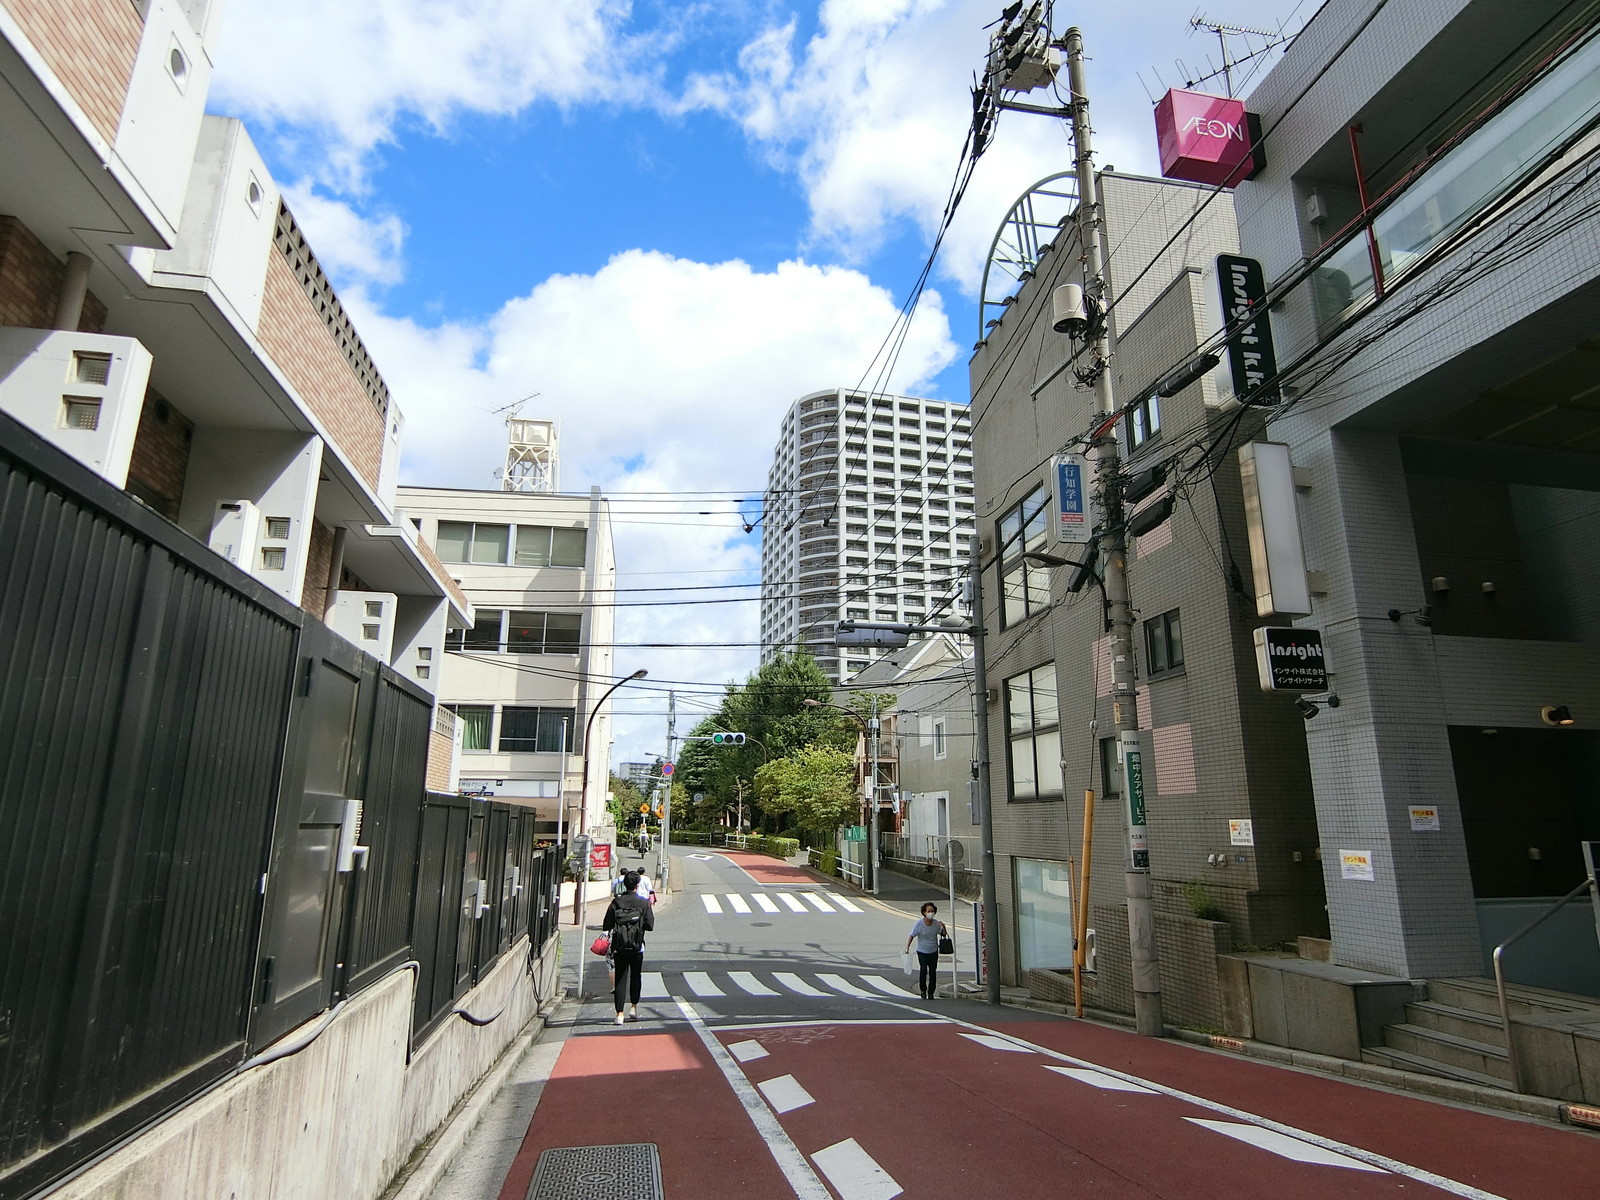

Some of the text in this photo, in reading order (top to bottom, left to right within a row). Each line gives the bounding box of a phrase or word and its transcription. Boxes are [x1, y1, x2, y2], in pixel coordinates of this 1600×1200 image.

[1065, 467, 1077, 511] 行知学園
[1269, 642, 1322, 660] Insight
[1274, 667, 1324, 676] インサイト株式会社
